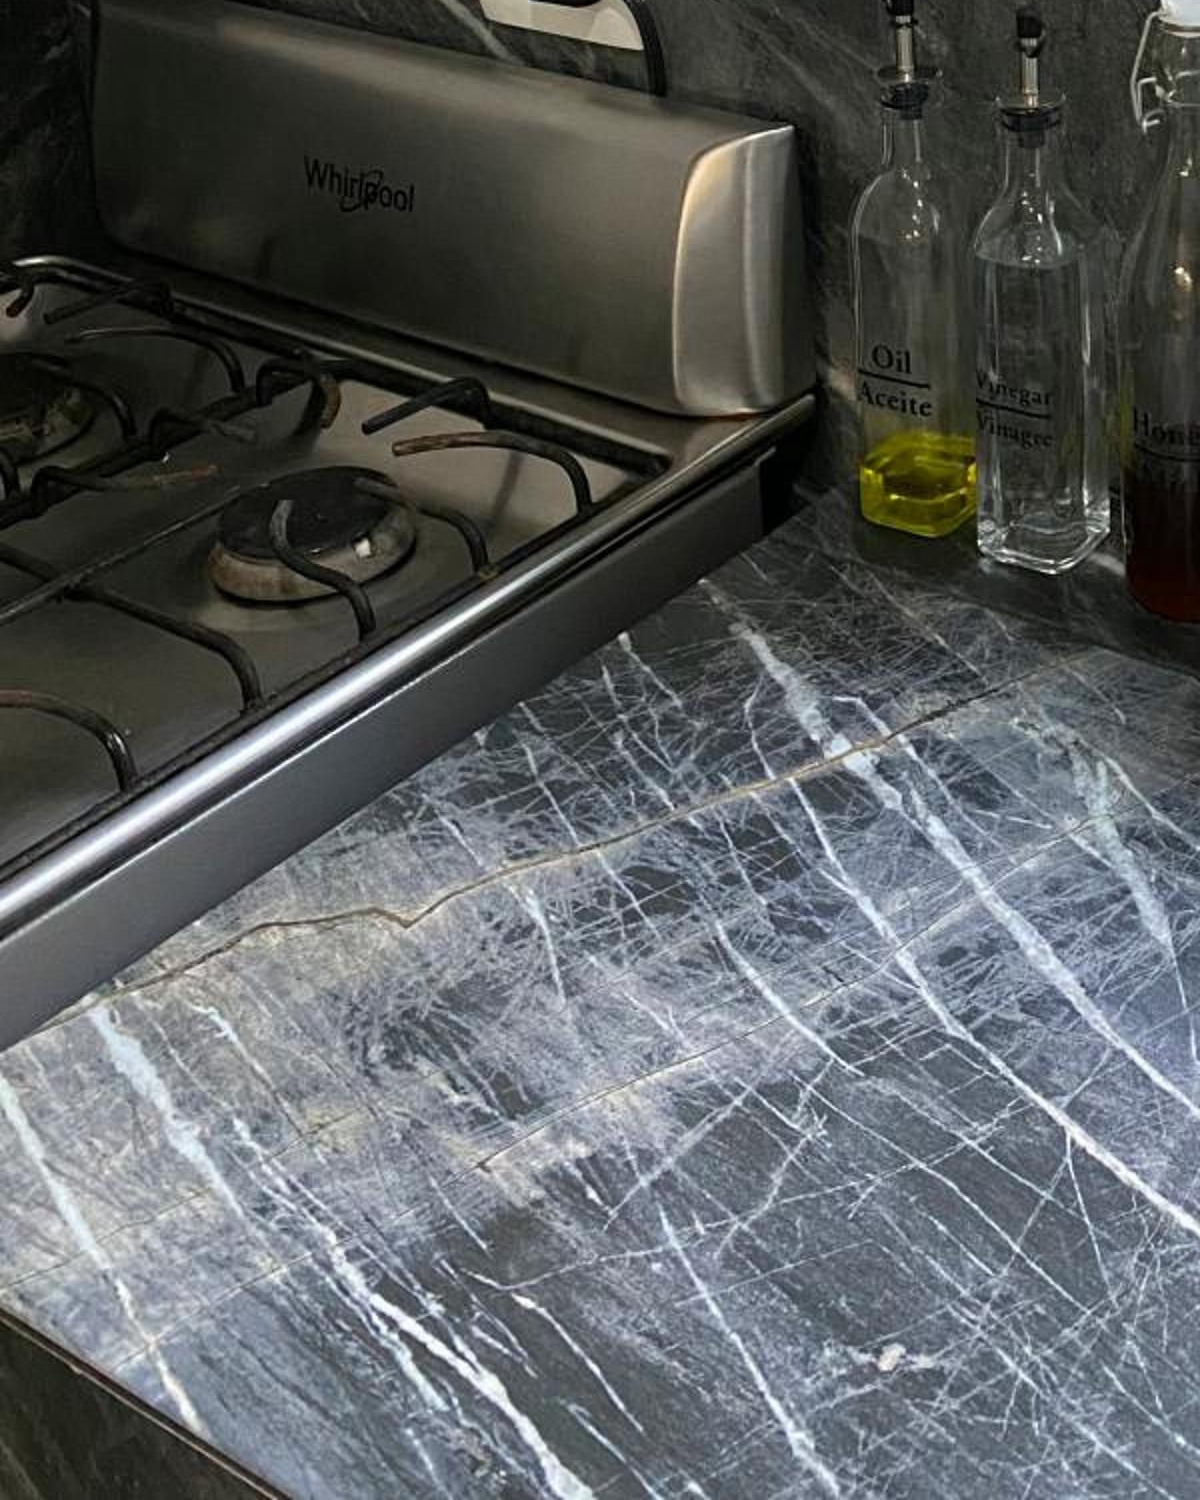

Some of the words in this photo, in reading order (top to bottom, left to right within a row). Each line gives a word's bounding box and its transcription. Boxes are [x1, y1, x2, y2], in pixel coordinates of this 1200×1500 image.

[303, 156, 415, 213] Whirlpool
[871, 344, 912, 374] Oil
[858, 381, 933, 417] Aceite
[976, 368, 1052, 408] Vinegar
[976, 409, 1054, 451] Vinagre
